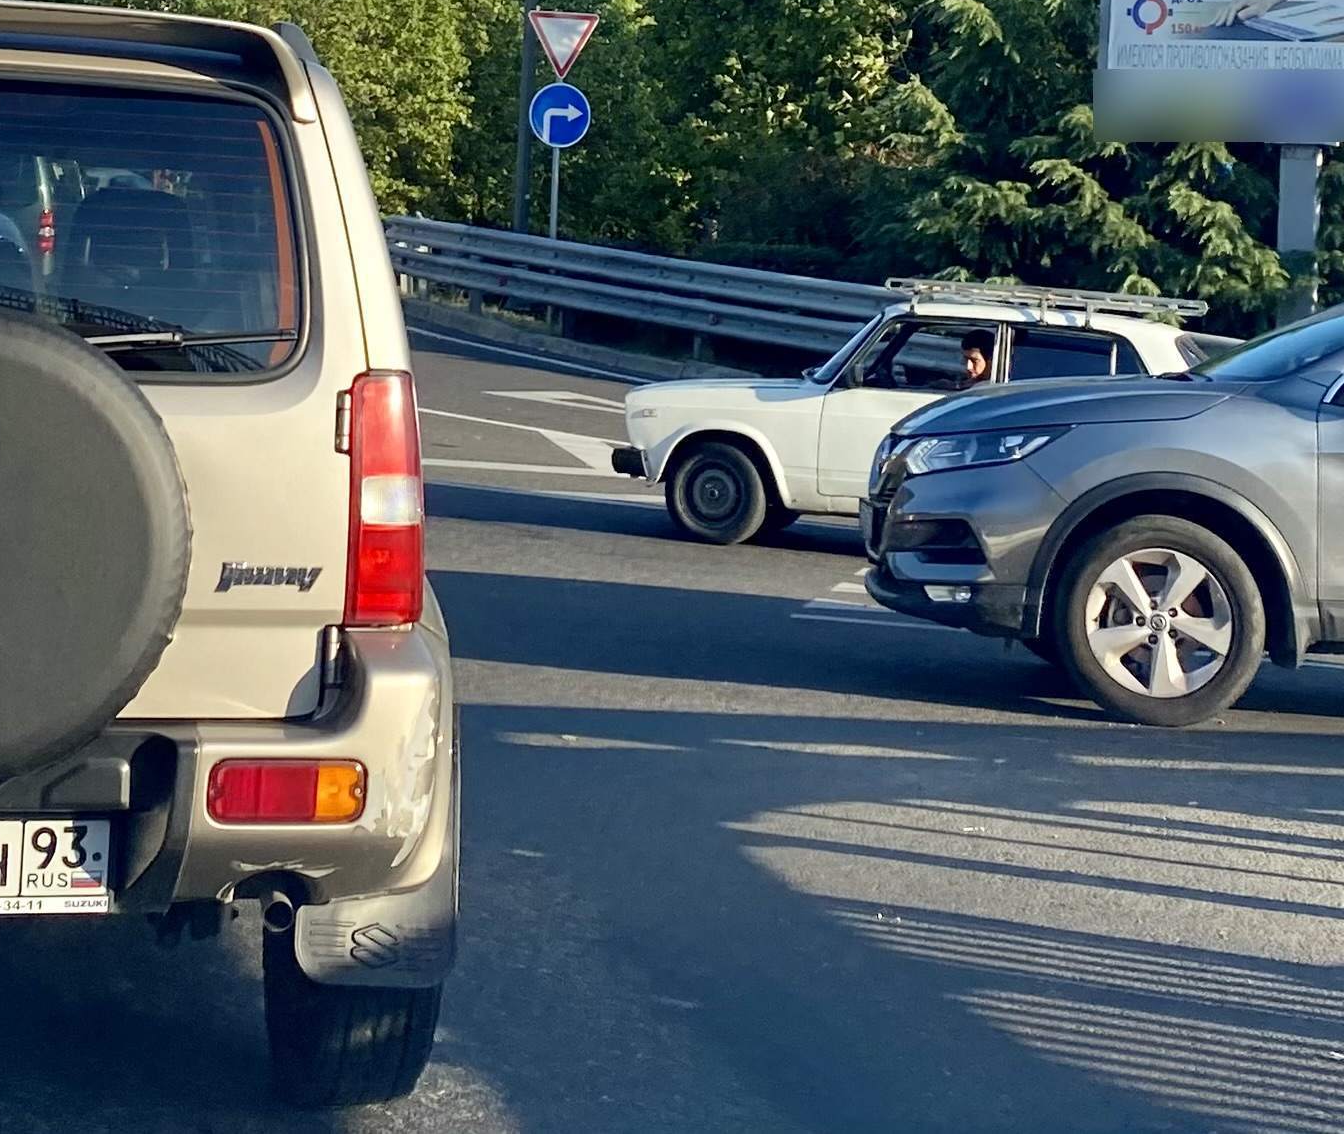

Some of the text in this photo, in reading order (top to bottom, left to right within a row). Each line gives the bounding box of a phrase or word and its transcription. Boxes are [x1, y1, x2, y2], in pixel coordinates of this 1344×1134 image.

[1171, 23, 1193, 35] 150
[31, 826, 87, 869] 93
[27, 872, 68, 889] RUS
[64, 899, 107, 908] SUZUKI
